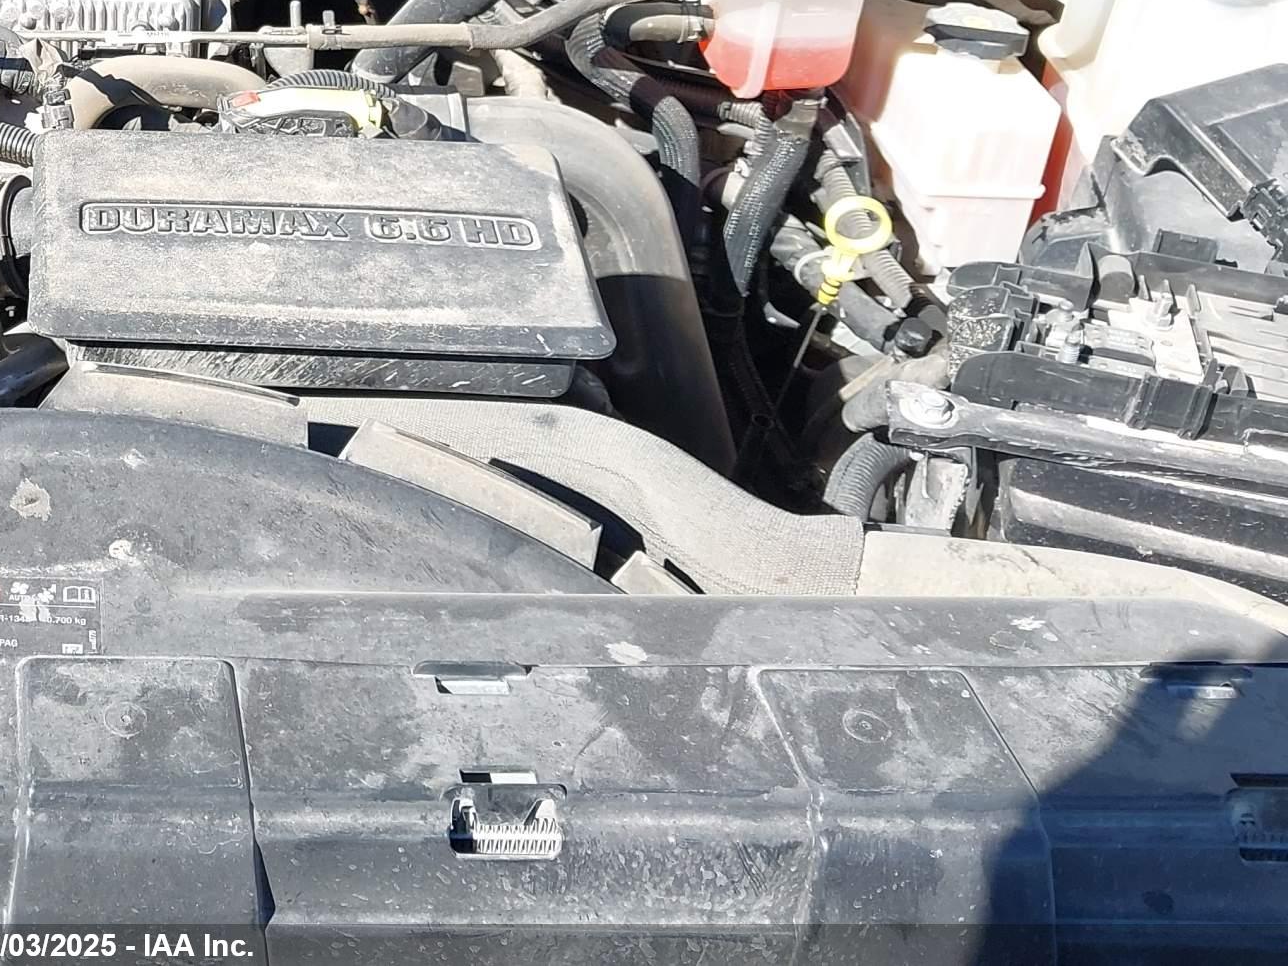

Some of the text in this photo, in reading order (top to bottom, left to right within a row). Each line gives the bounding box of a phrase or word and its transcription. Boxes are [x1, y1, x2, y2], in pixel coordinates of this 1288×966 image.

[87, 207, 534, 246] DURAMAX 6.6 HD
